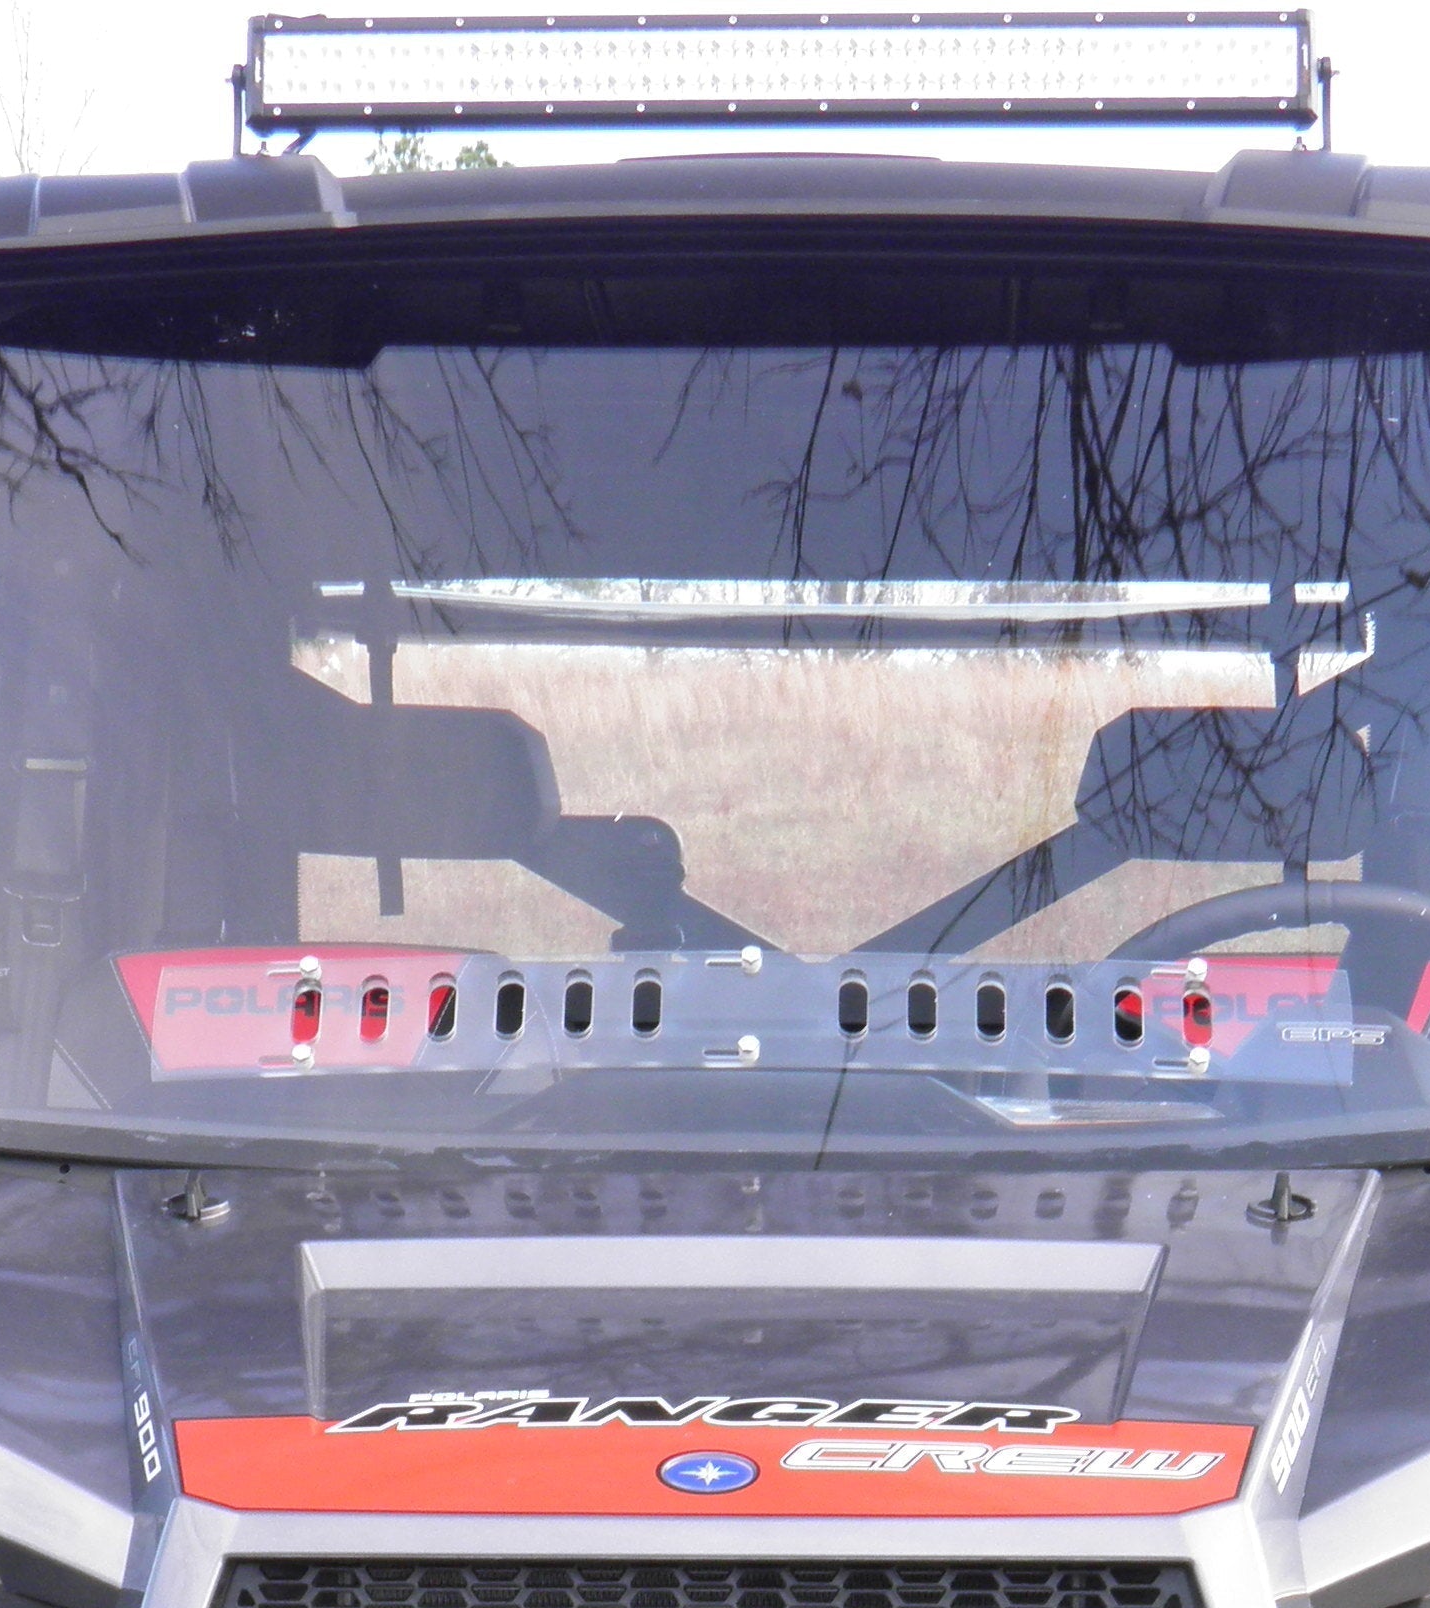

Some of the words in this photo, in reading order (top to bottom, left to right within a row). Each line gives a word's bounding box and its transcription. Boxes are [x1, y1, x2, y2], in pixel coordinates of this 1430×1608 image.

[164, 985, 405, 1018] POLARIS
[325, 1396, 1082, 1434] RANGER
[408, 1389, 550, 1404] POLARIS
[133, 1391, 162, 1483] 900
[1271, 1385, 1311, 1496] 900
[779, 1438, 1227, 1480] CREW
